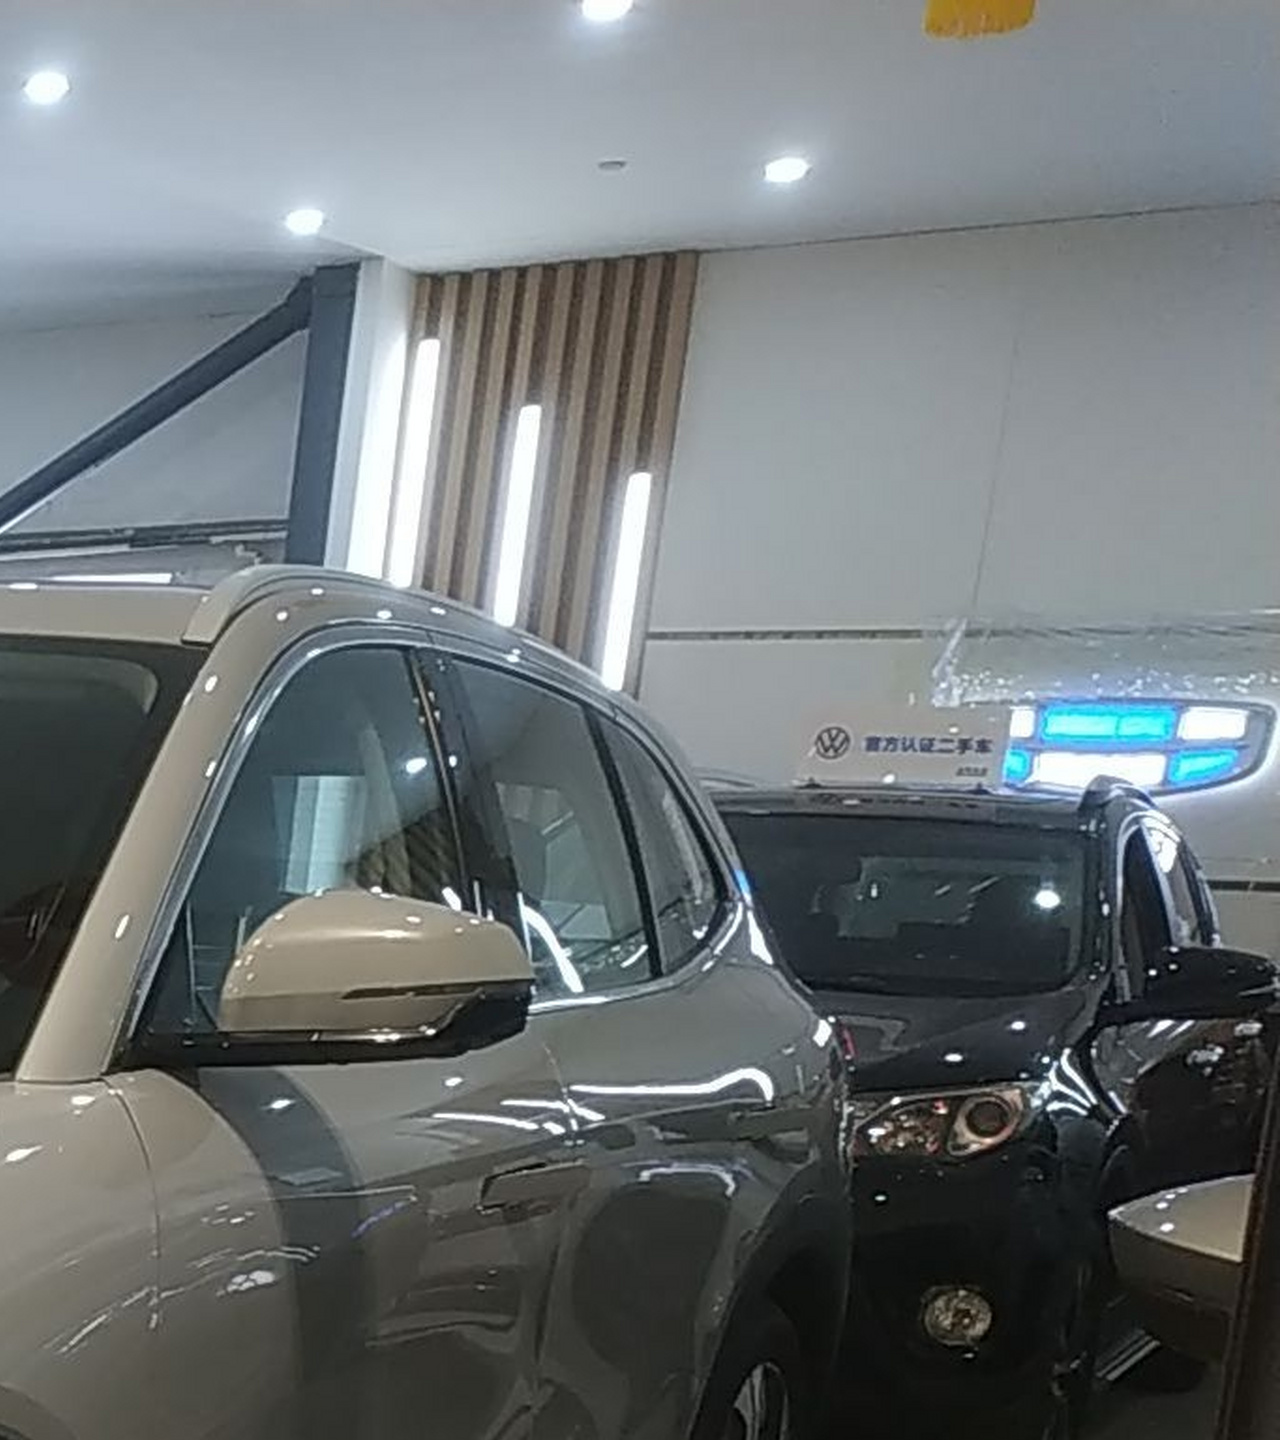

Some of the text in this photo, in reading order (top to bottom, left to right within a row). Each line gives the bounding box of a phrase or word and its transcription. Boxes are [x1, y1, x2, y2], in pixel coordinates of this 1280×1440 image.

[865, 736, 992, 755] 官方认证二手车
